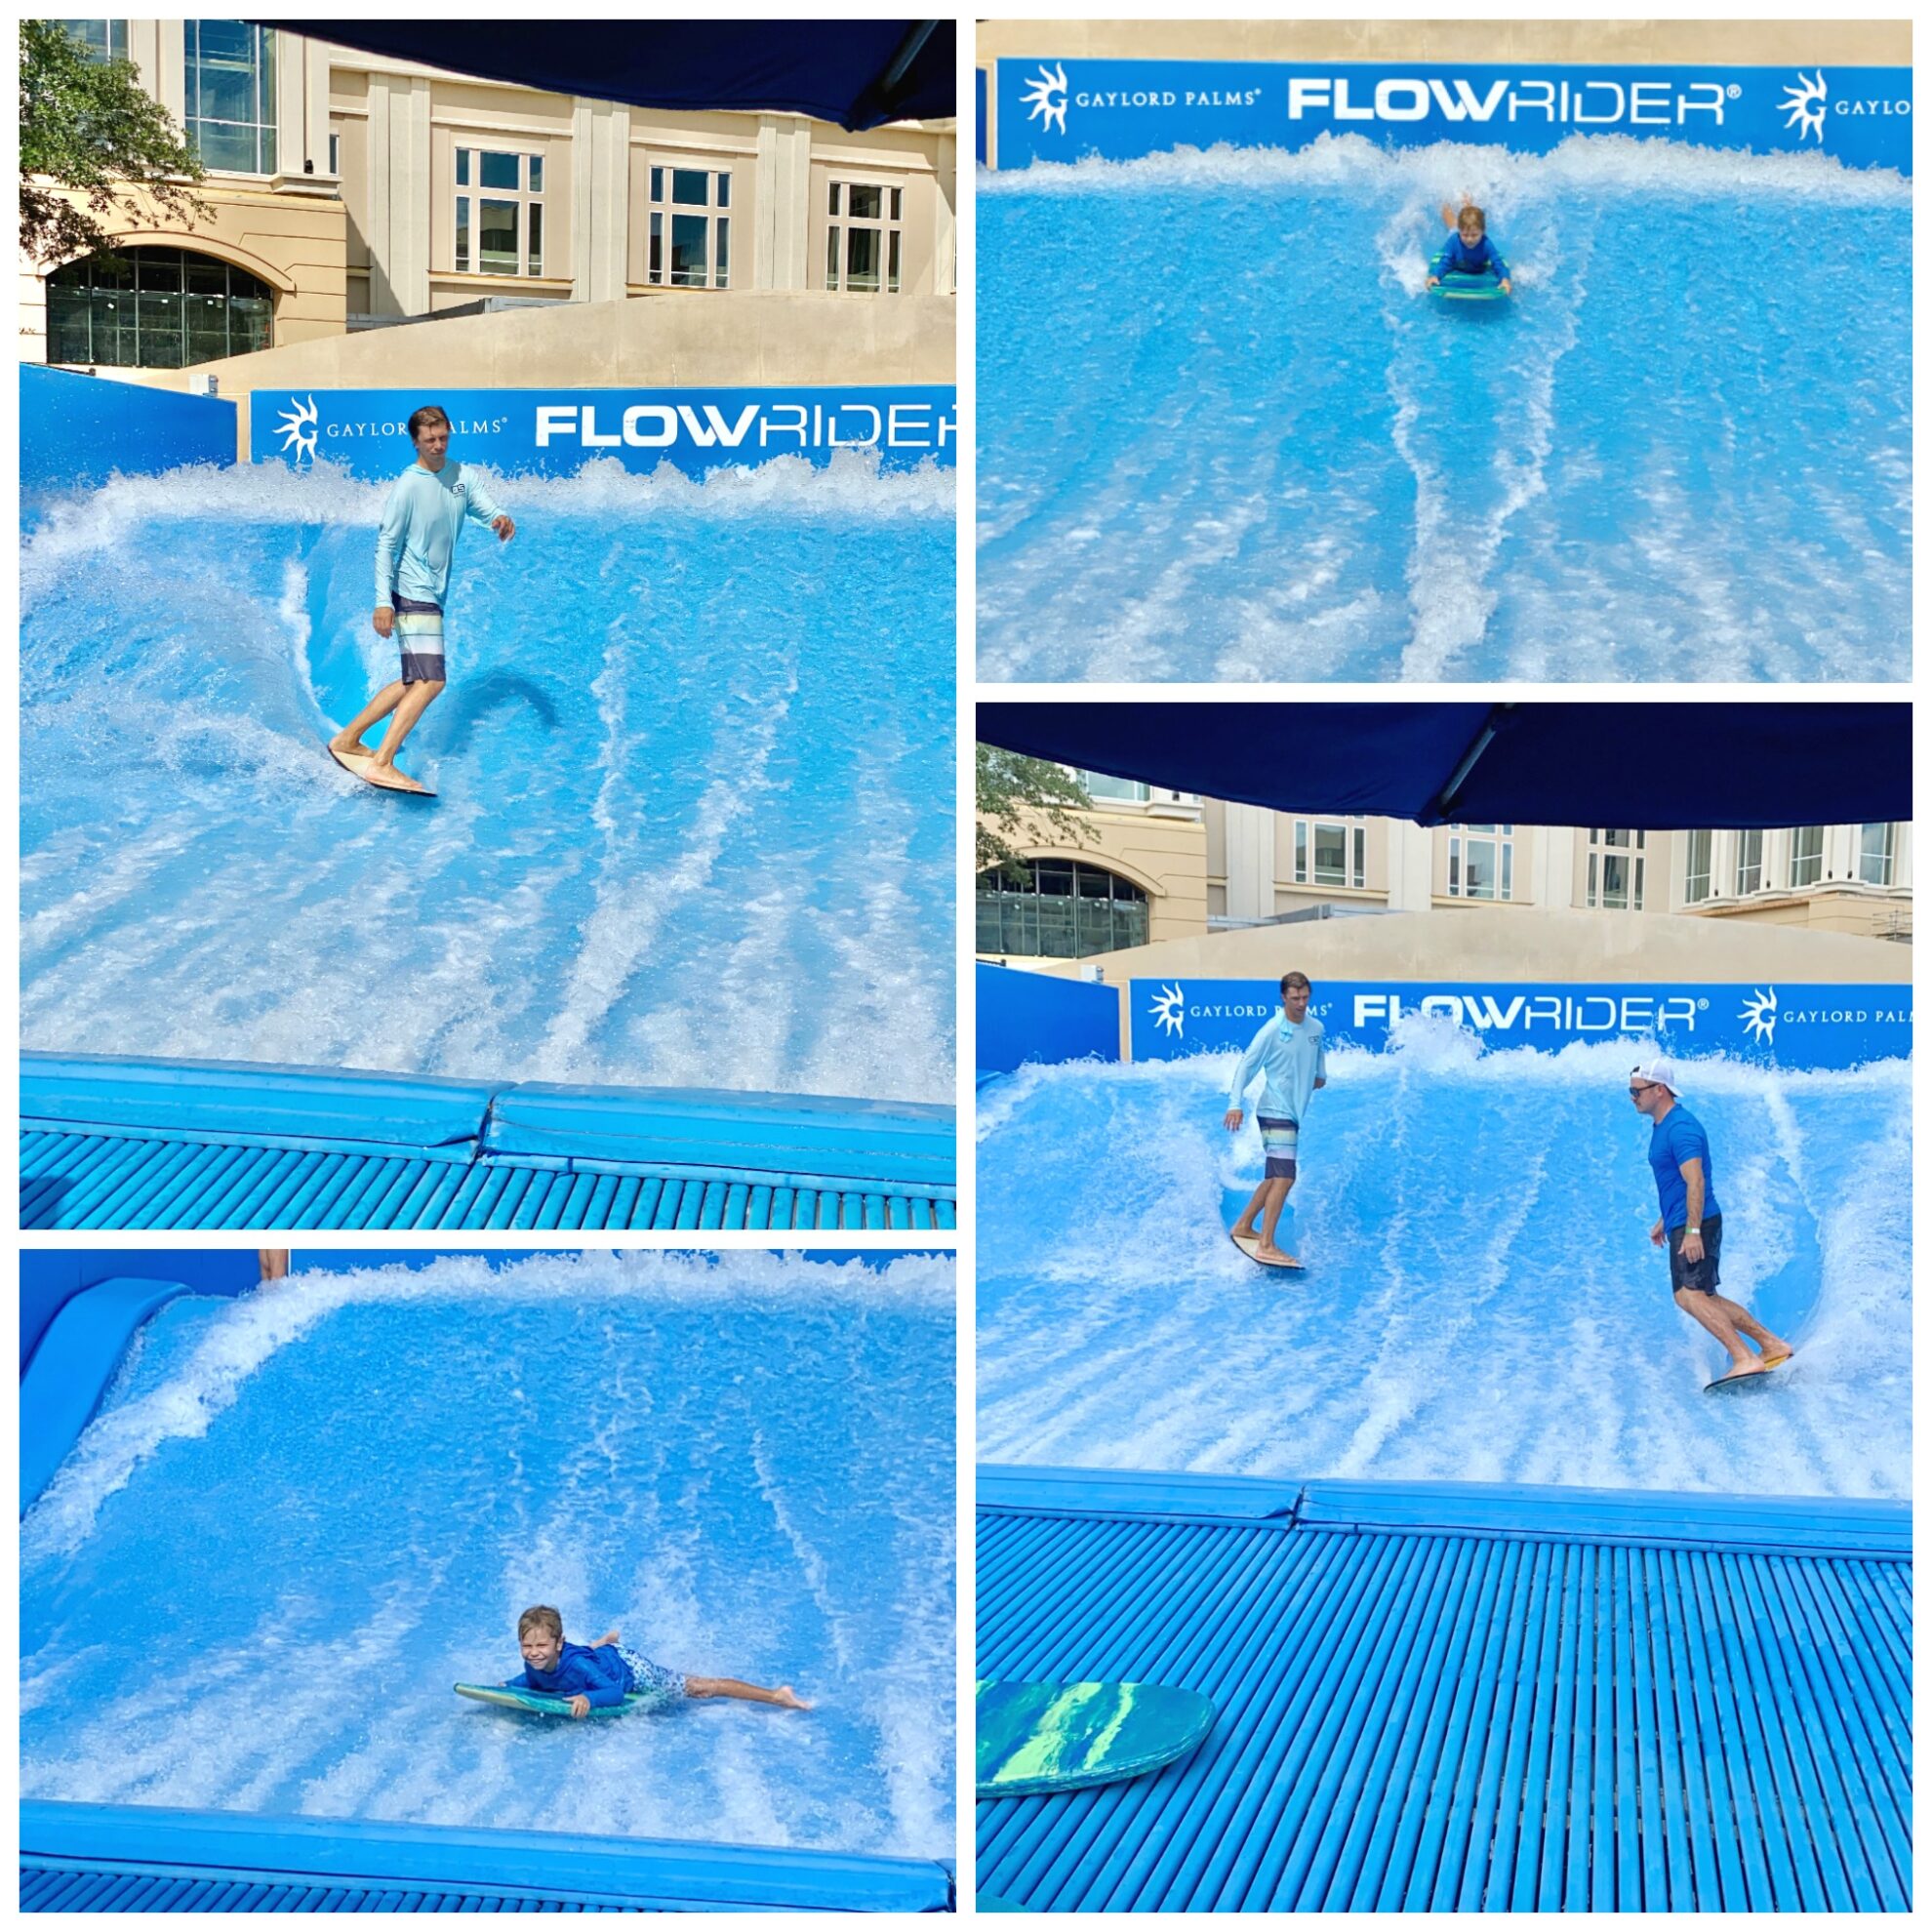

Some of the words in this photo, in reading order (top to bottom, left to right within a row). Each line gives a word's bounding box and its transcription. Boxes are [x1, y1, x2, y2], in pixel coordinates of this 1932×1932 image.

[1075, 92, 1177, 107] GAYLORD
[1834, 100, 1912, 115] GAYLO
[326, 422, 408, 438] GAYLOR
[449, 417, 508, 434] ALMS
[1189, 1005, 1268, 1018] GAYLORD
[1273, 1002, 1333, 1017] PMS
[1783, 1010, 1868, 1024] GAYLORD
[1875, 1010, 1912, 1023] PAL
